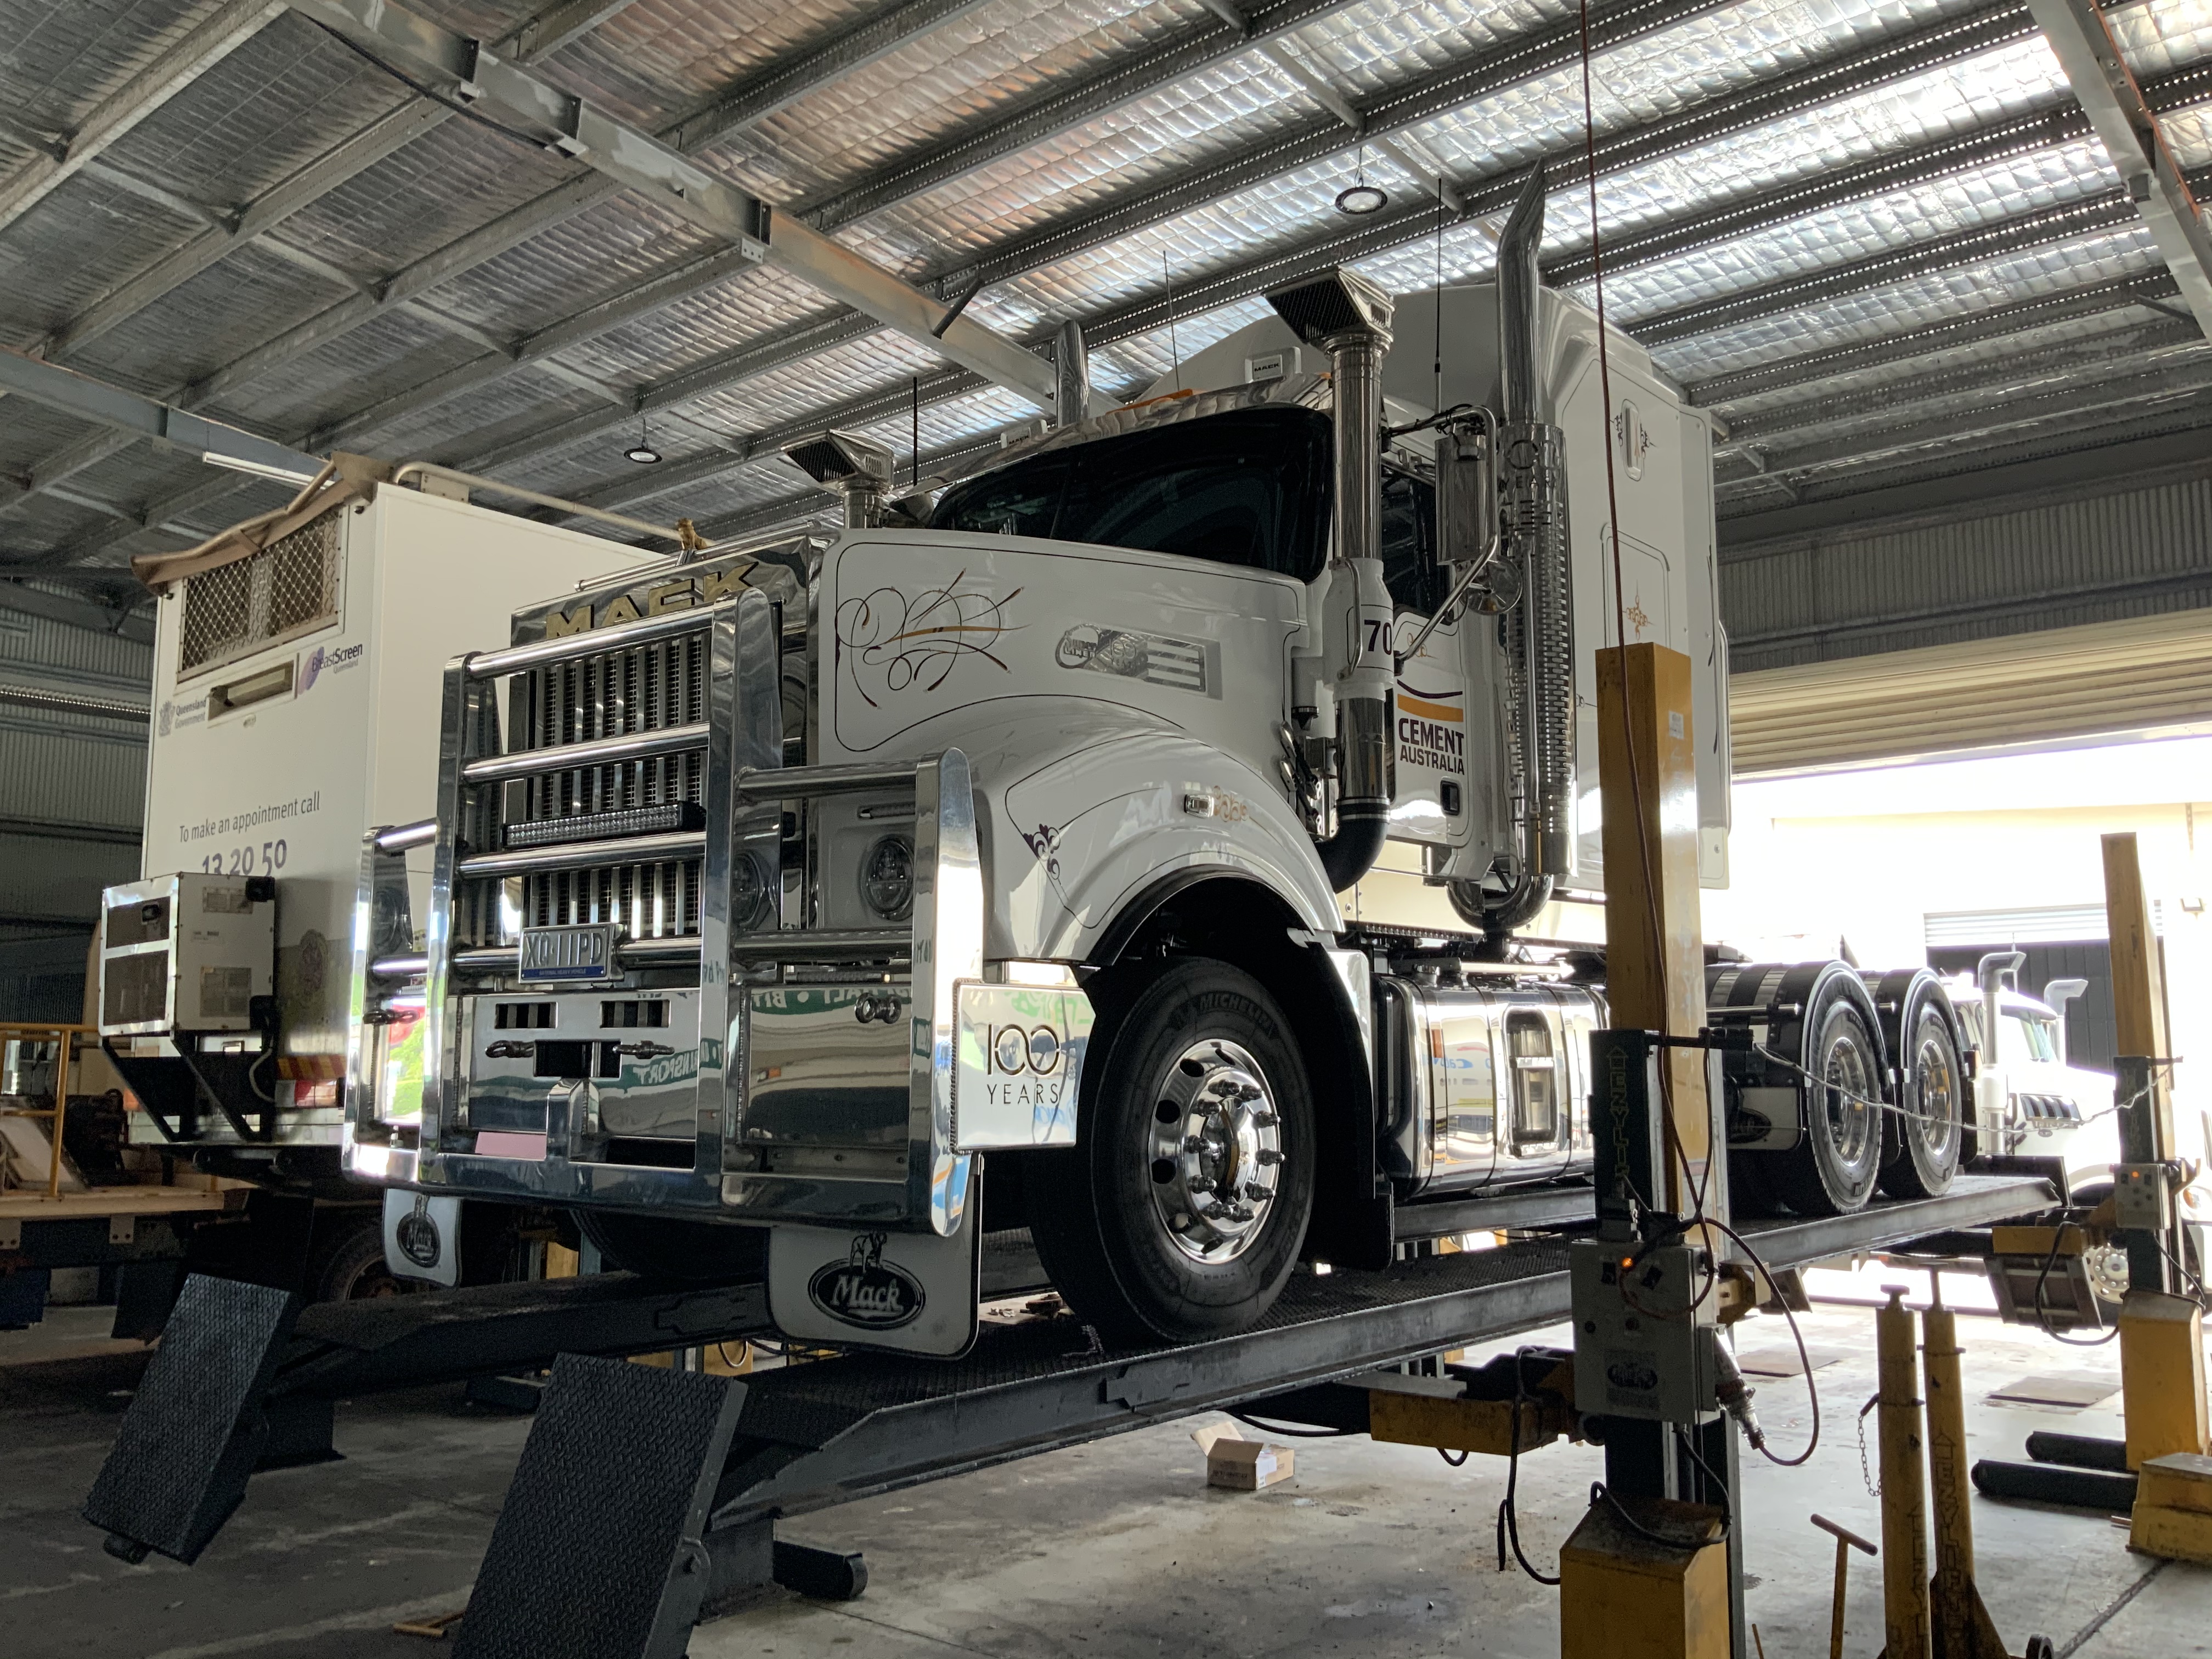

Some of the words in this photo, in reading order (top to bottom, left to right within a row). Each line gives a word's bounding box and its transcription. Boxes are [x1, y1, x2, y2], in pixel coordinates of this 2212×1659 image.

[1254, 363, 1279, 372] MACK
[546, 561, 759, 640] MACK
[1364, 619, 1392, 656] 70
[312, 643, 363, 673] BreastScreen
[175, 713, 206, 730] Government
[176, 697, 206, 716] Queensland
[1398, 718, 1464, 756] CEMENT
[1400, 744, 1465, 775] AUSTRALIA
[180, 825, 189, 843] To
[191, 817, 216, 840] make
[219, 817, 230, 834] an
[233, 798, 298, 834] appointment
[301, 791, 319, 814] call
[202, 853, 222, 875] 13
[230, 846, 254, 876] 20
[262, 839, 287, 877] 50
[988, 1024, 1061, 1075] 100
[987, 1084, 1059, 1104] YEARS
[407, 1223, 433, 1255] Mack
[830, 1274, 904, 1317] Mack
